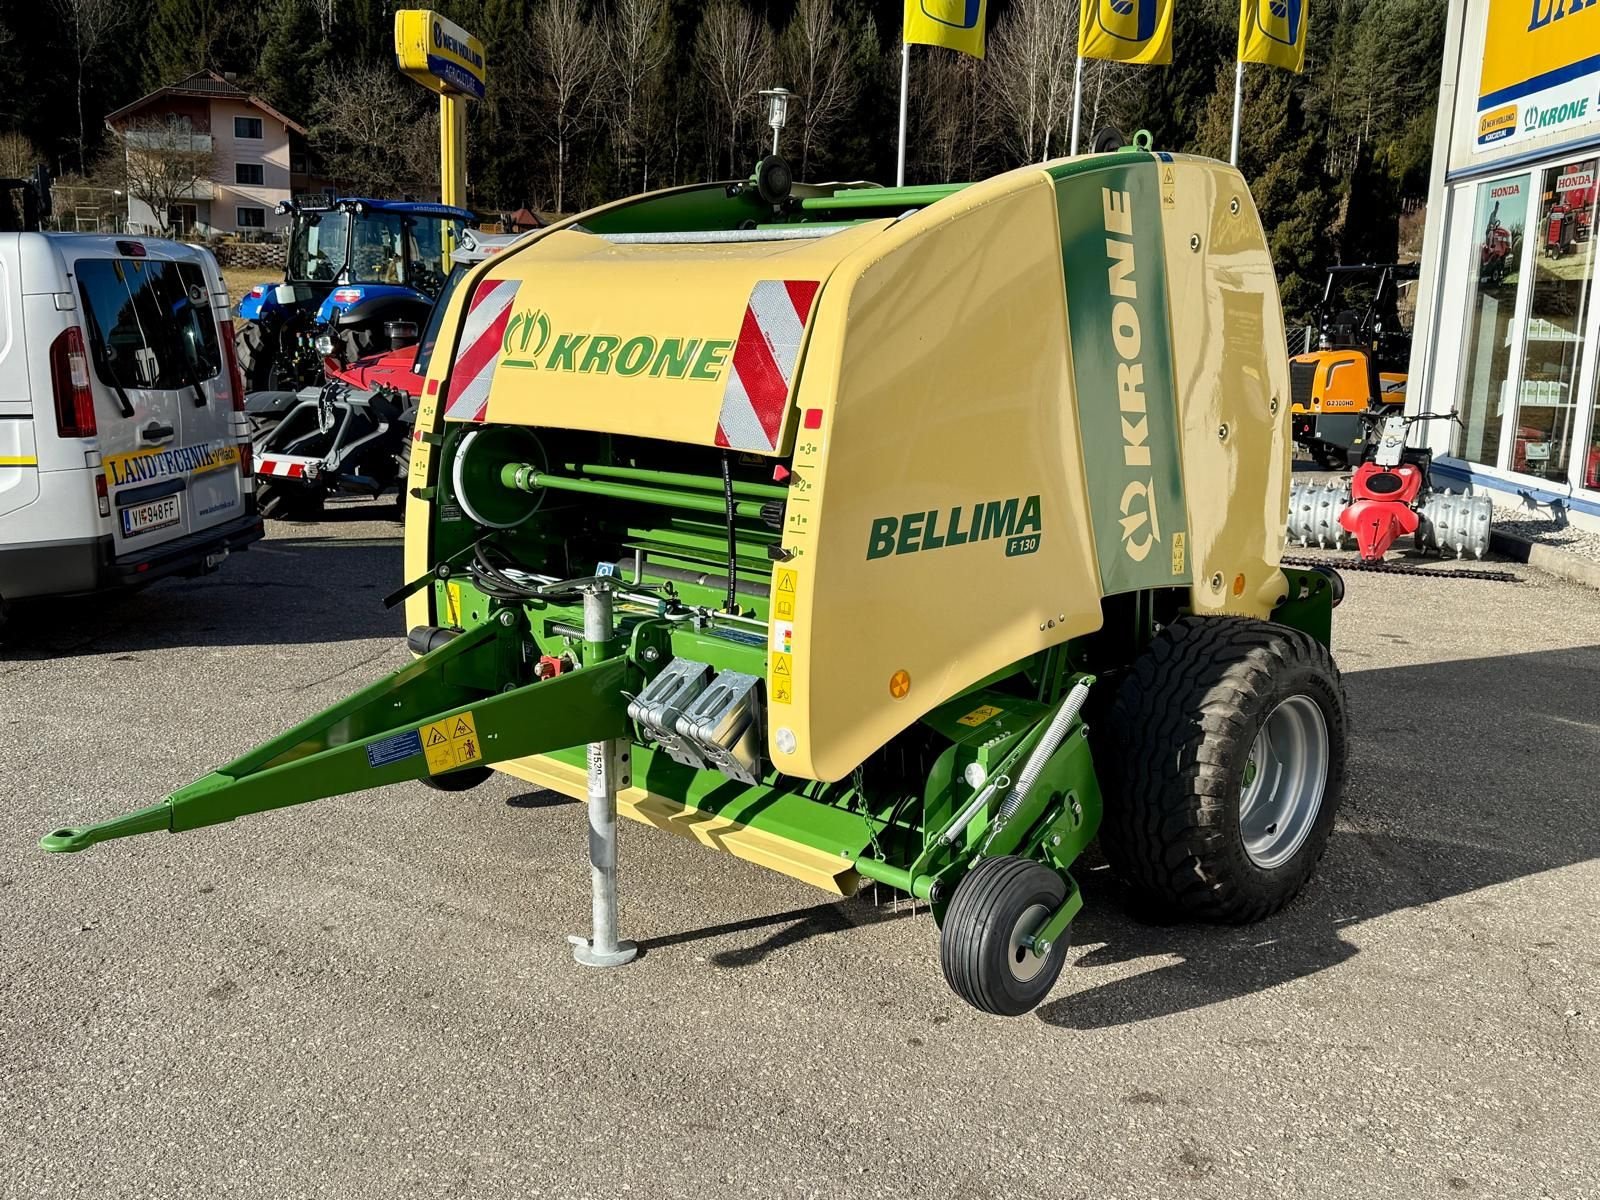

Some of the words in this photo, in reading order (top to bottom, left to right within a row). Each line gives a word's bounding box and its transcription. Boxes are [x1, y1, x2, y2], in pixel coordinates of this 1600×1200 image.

[443, 32, 458, 55] NEW
[458, 42, 483, 69] HOLLAND
[445, 65, 476, 90] AGRICULTURE
[1487, 119, 1496, 128] NEW
[1496, 113, 1515, 125] HOLLAND
[1538, 97, 1589, 128] KRONE
[1491, 184, 1520, 198] HONDA
[1558, 174, 1591, 189] HONDA
[1102, 187, 1151, 466] KRONE
[545, 333, 736, 381] KRONE
[805, 443, 812, 455] 3
[109, 443, 214, 486] LANDTECHNIK
[866, 494, 1042, 561] BELLIMA
[1010, 541, 1017, 553] F
[1019, 538, 1036, 552] 130
